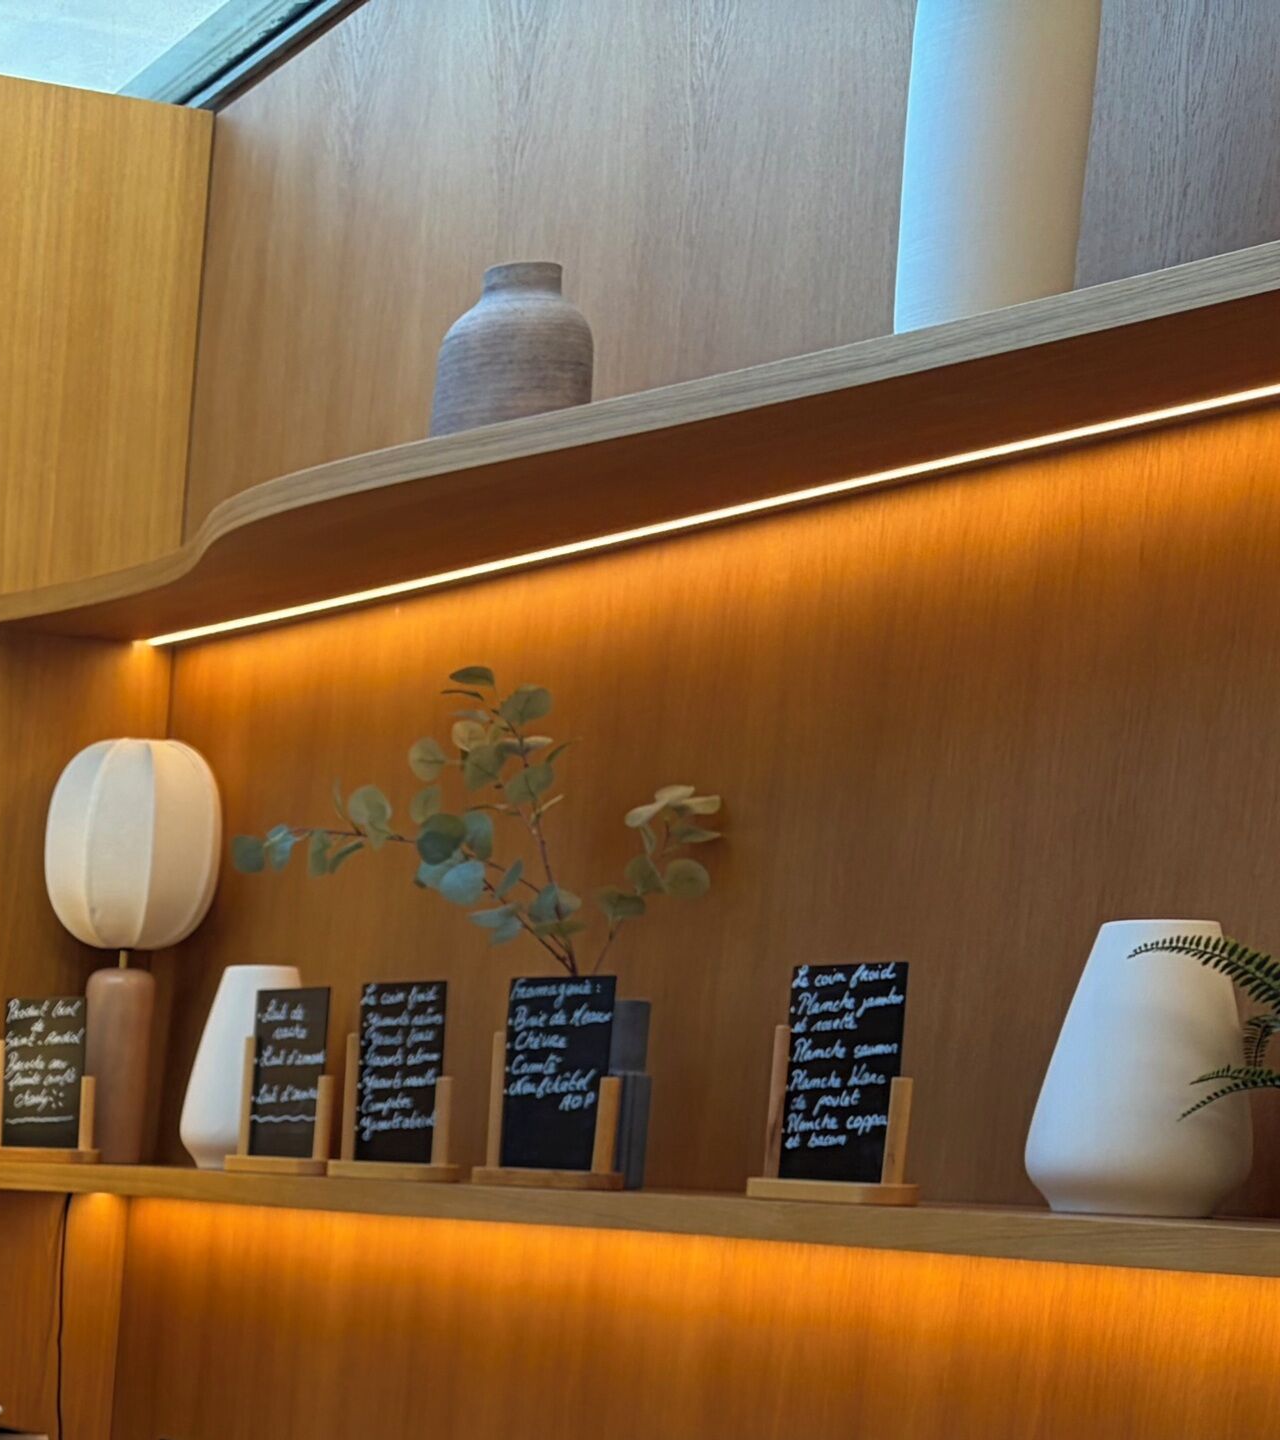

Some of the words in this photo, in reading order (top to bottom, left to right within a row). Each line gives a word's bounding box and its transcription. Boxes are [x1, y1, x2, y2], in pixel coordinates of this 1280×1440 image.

[814, 968, 847, 987] coin
[849, 962, 896, 989] froid
[798, 989, 856, 1015] Planche
[549, 1009, 567, 1026] de
[792, 1037, 848, 1063] Planche
[790, 1069, 843, 1091] Planche
[558, 1092, 596, 1112] AOP
[812, 1088, 861, 1117] poulet
[787, 1113, 839, 1134] Planche
[846, 1114, 889, 1136] coppa
